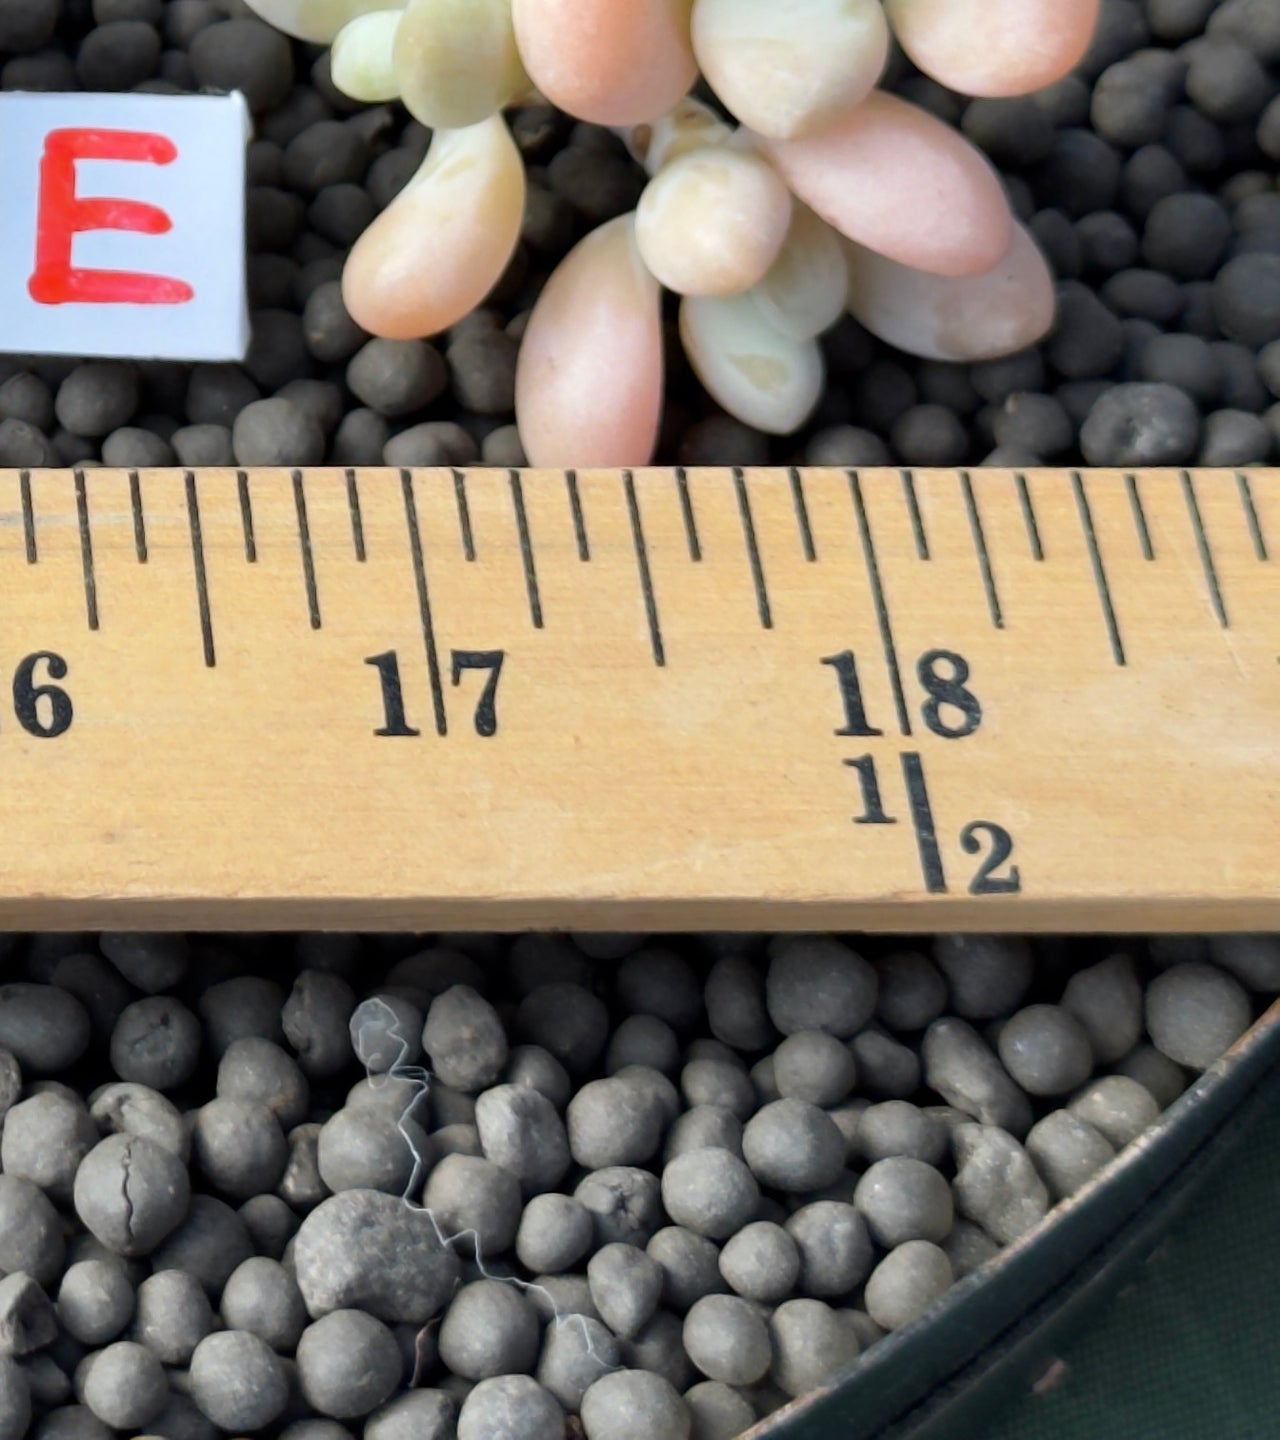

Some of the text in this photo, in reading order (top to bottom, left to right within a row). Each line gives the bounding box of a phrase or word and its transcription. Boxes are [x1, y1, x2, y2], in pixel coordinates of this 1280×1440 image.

[29, 128, 192, 305] E
[364, 649, 507, 738] 17
[820, 649, 982, 739] 18
